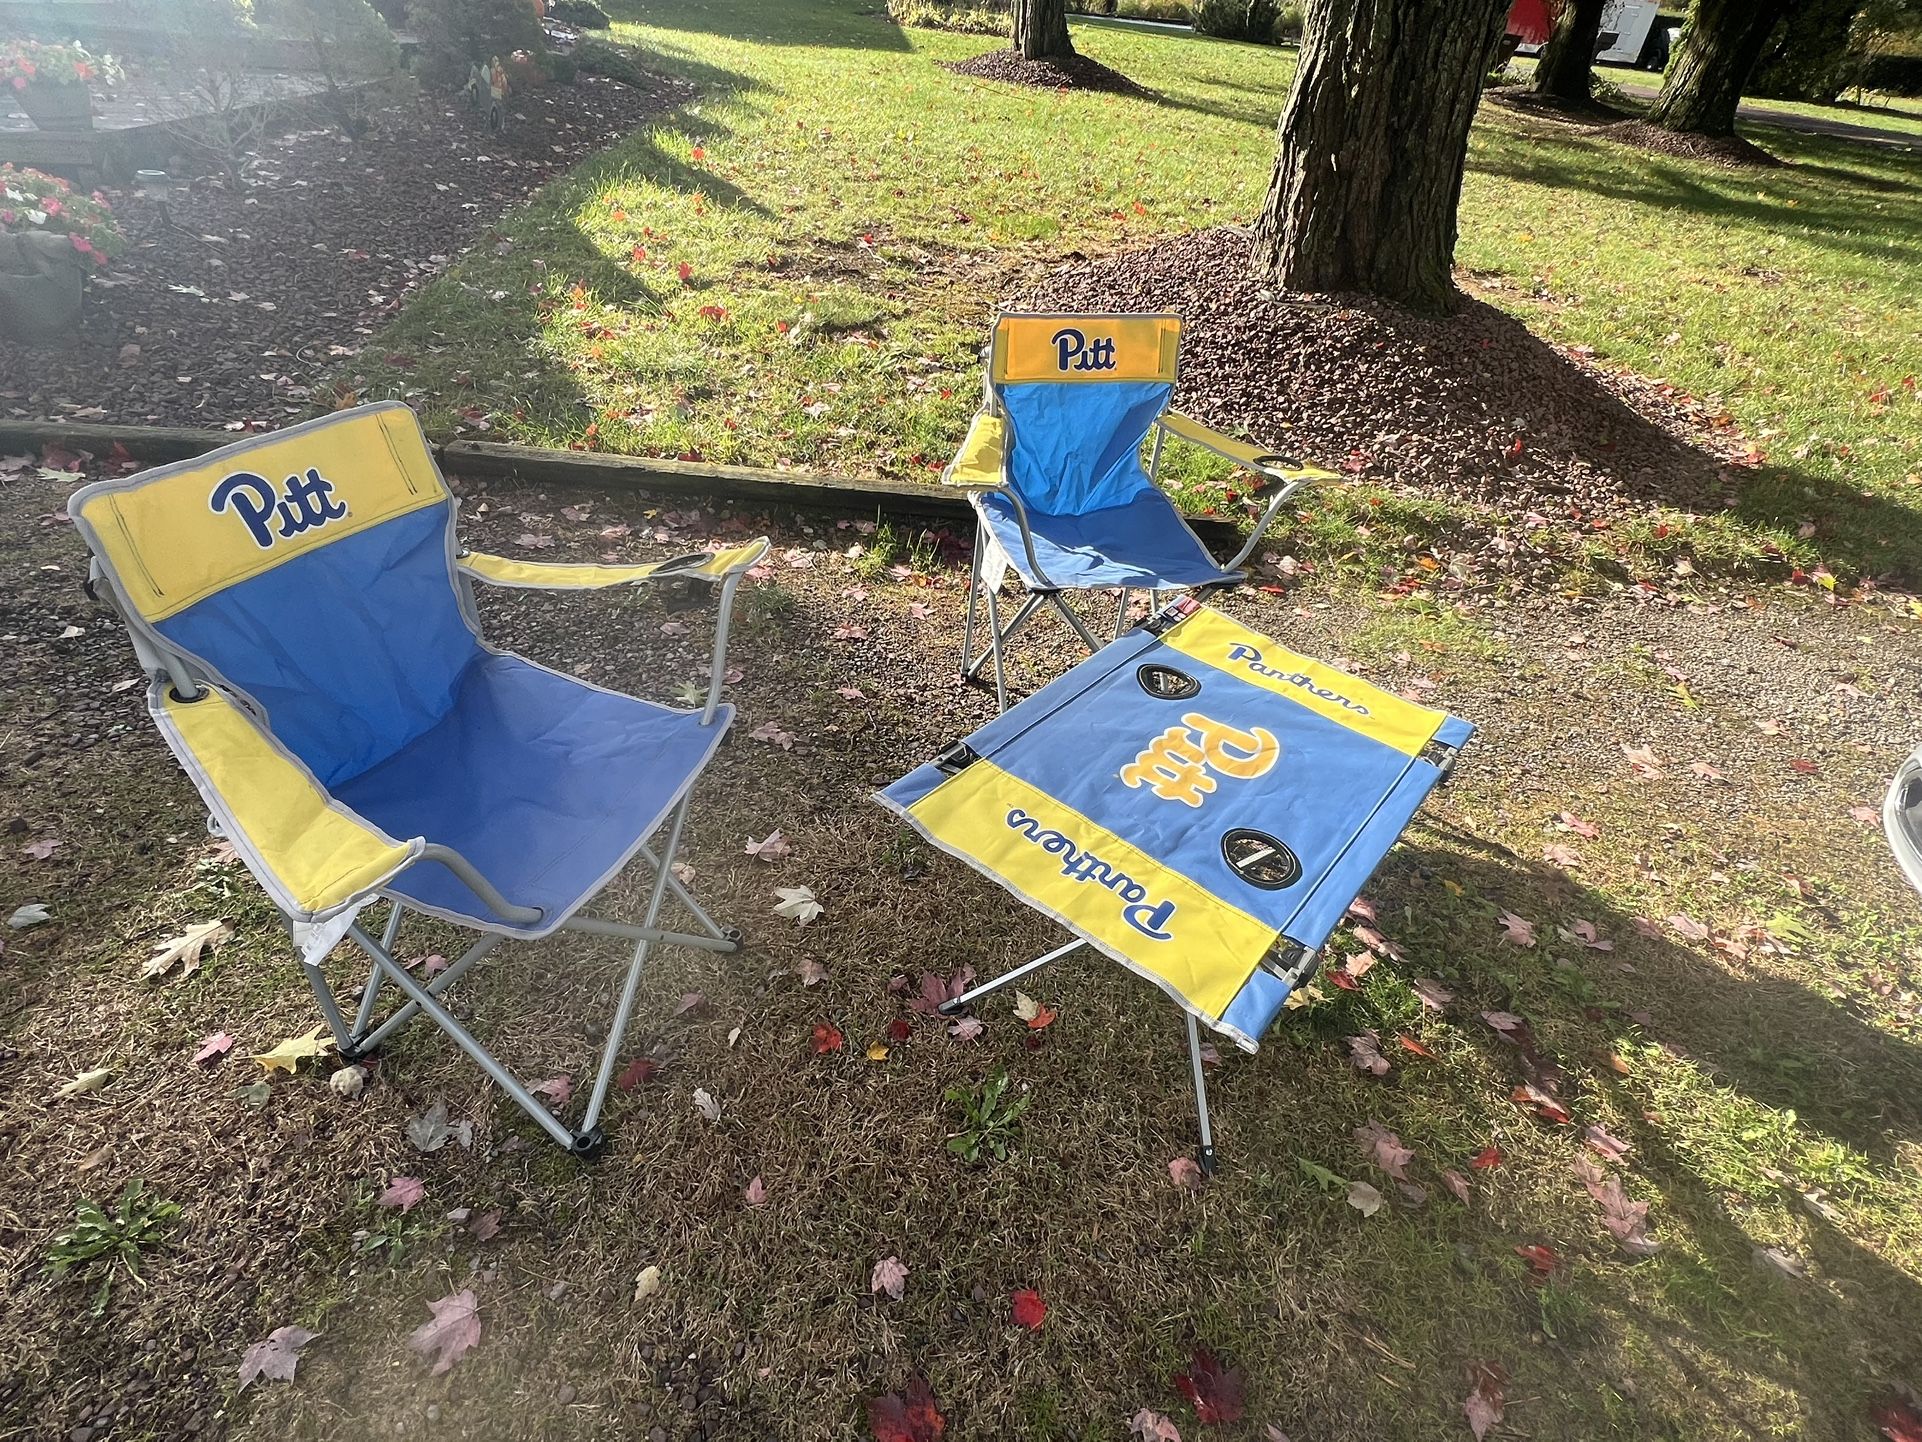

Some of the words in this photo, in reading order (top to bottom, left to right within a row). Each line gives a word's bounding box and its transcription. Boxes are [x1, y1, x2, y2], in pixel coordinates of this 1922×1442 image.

[1050, 327, 1116, 372] Pitt
[209, 467, 347, 549] Pitt
[1229, 642, 1370, 716] Panthers
[1120, 712, 1280, 808] Pitt
[1005, 808, 1175, 941] Panthers
